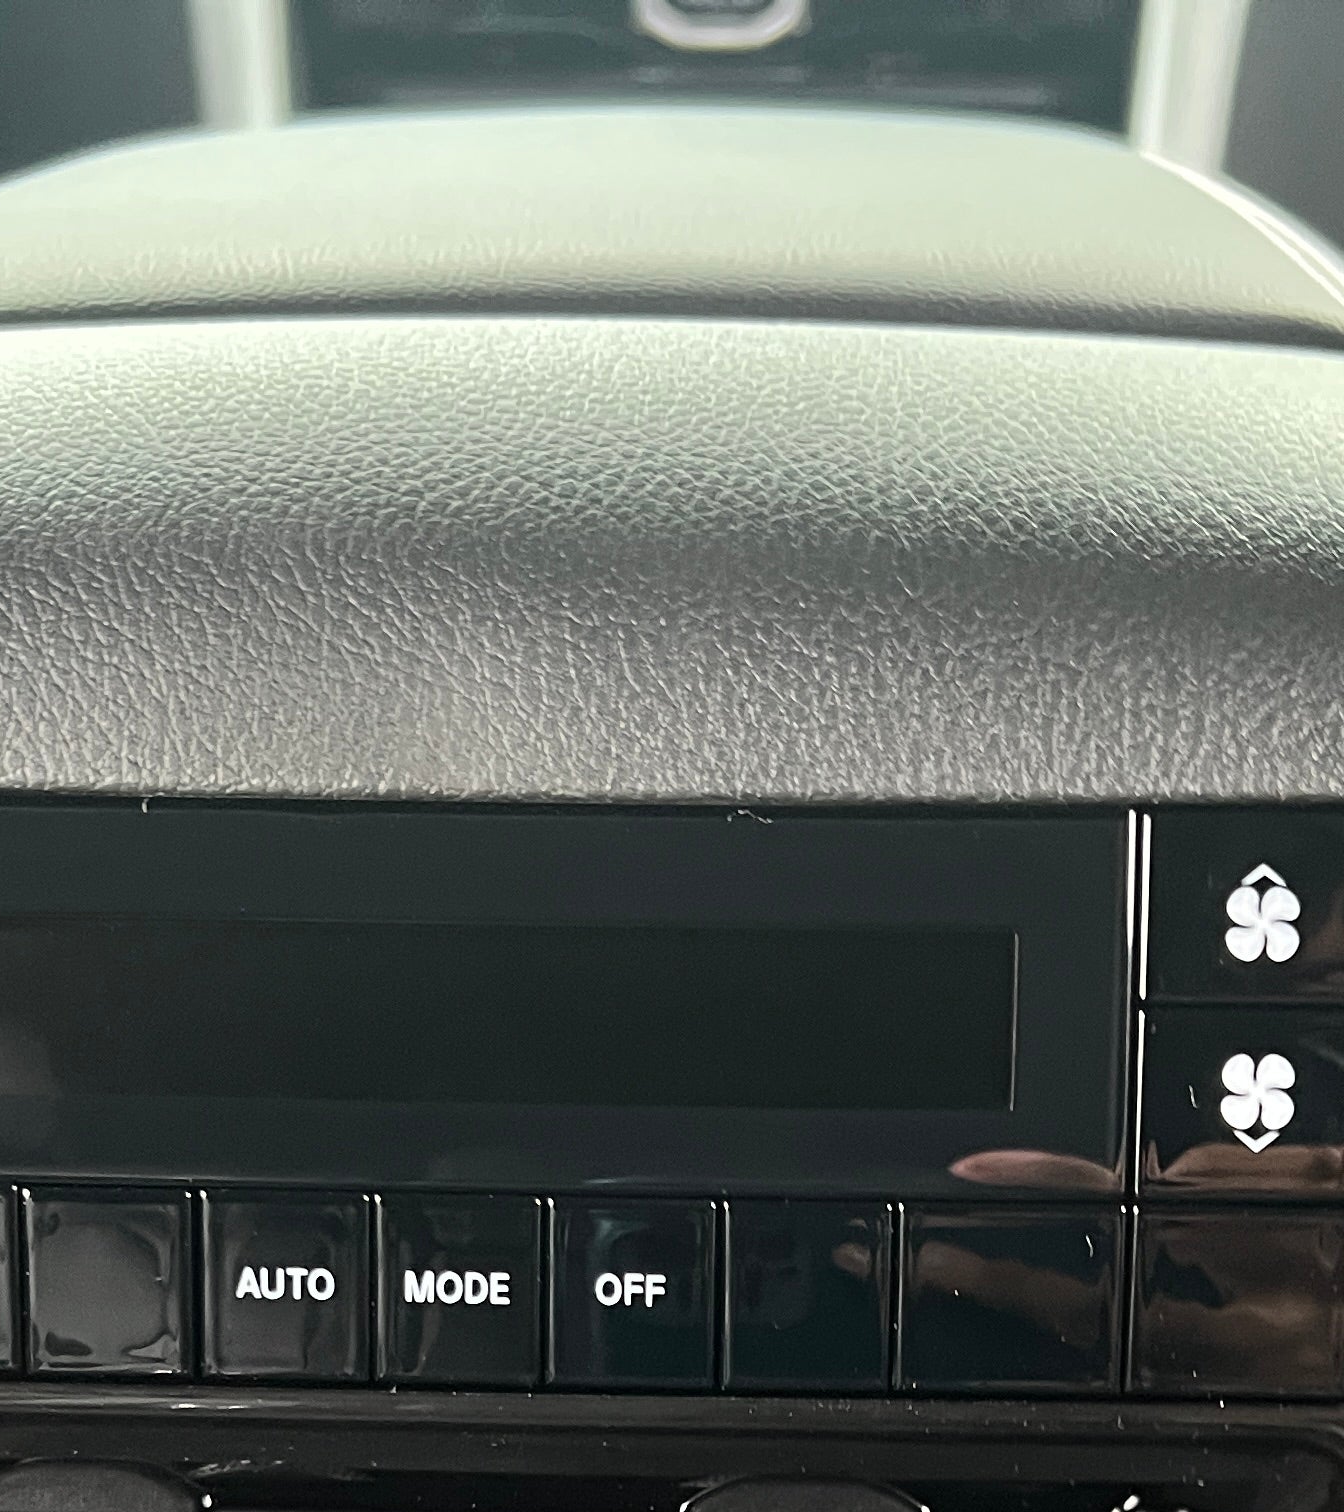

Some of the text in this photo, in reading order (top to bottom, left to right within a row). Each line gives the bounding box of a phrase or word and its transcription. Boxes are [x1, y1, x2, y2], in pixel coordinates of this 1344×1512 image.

[235, 1266, 336, 1301] AUTO
[404, 1270, 511, 1305] MODE
[594, 1273, 667, 1307] OFF
